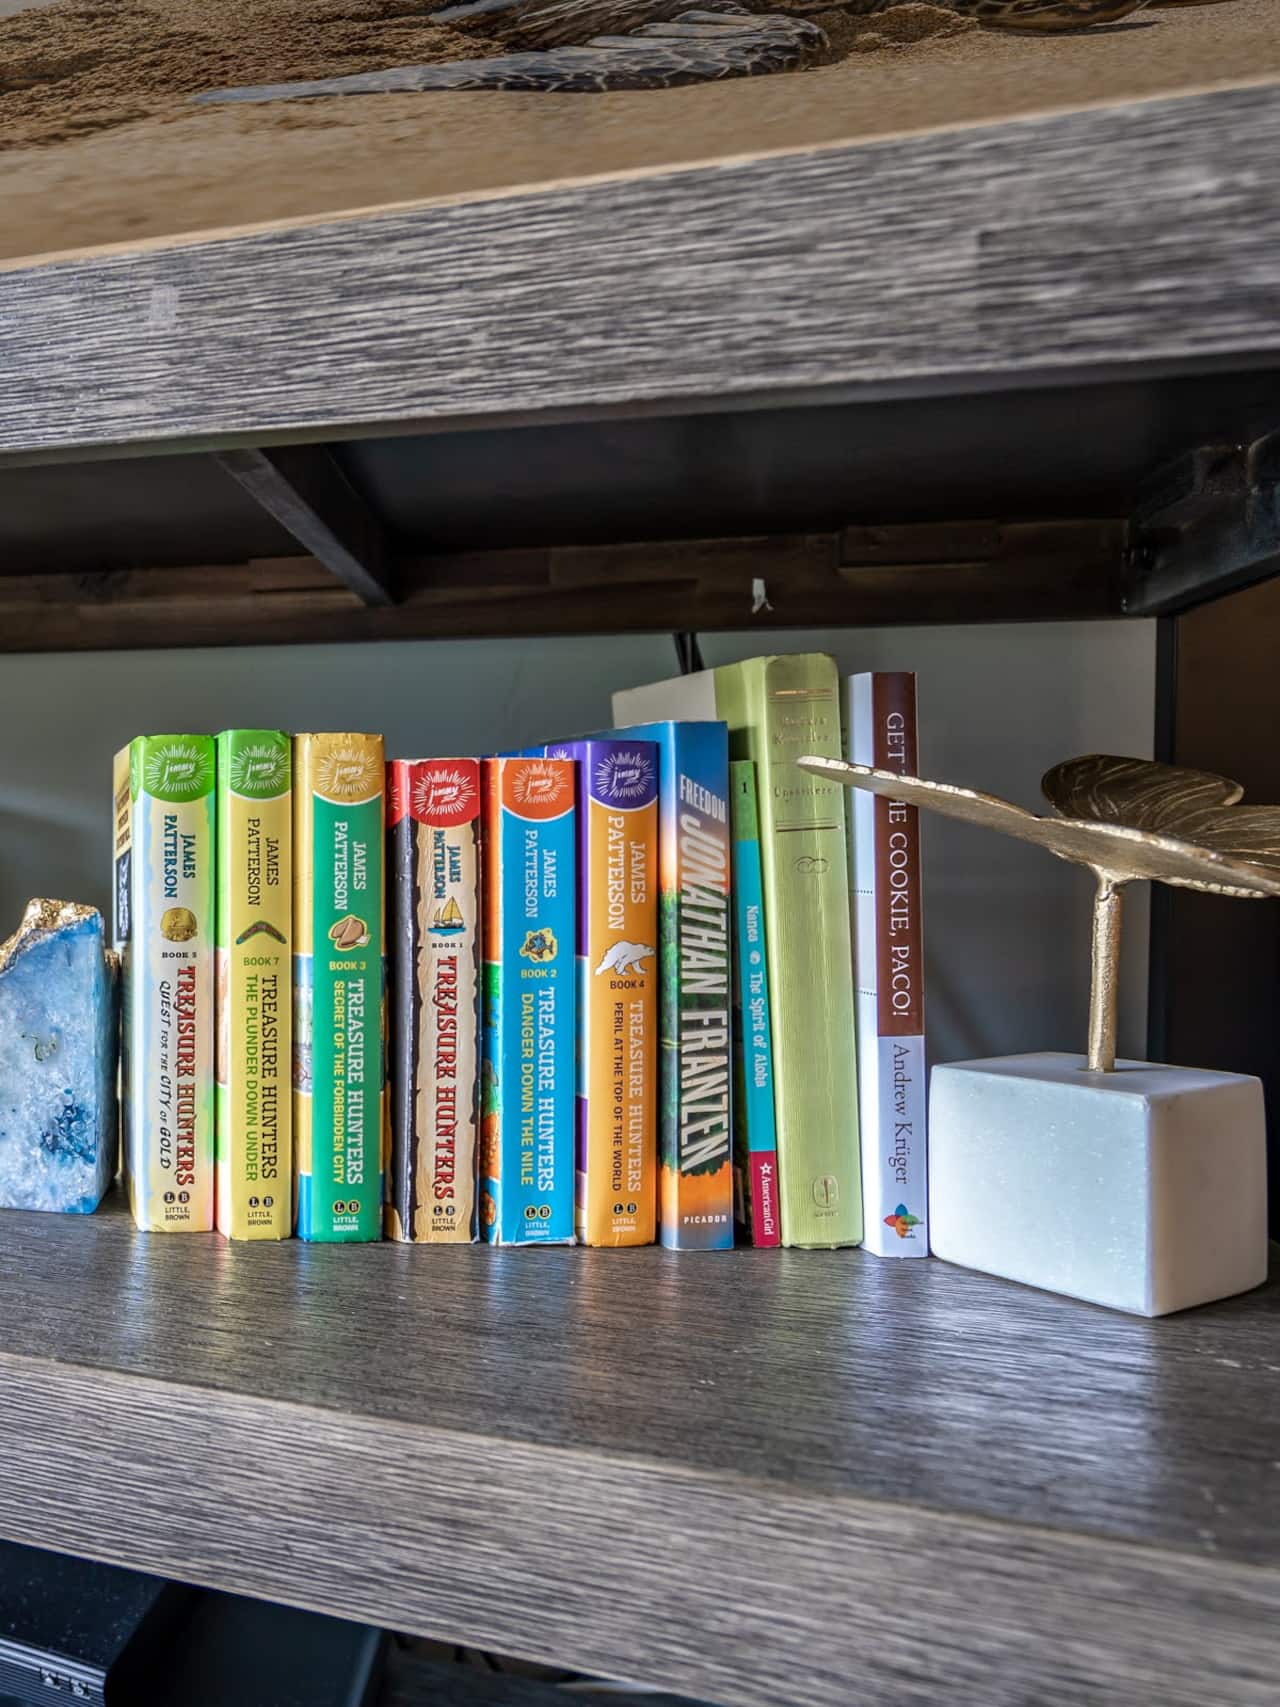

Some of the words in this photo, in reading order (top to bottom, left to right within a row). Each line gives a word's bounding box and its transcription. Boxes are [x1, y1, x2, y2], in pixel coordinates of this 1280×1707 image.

[887, 712, 905, 763] GET
[679, 774, 726, 823] FREEDOM
[742, 783, 747, 793] 1
[164, 815, 177, 898] PATTERSON
[181, 834, 196, 879] JAMES
[248, 818, 260, 906] PATTERSON
[266, 837, 279, 886] JAMES
[334, 821, 348, 910] PATTERSON
[353, 842, 366, 890] JAMES
[434, 830, 446, 899] PATTERSON
[447, 846, 461, 883] JAMES
[525, 830, 538, 919] PATTERSON
[543, 849, 557, 898] JAMES
[608, 816, 625, 930] PATTERSON
[630, 842, 645, 904] JAMES
[680, 815, 728, 994] JONATHAN
[889, 832, 909, 937] COOKIE,
[747, 905, 758, 942] Nanea
[243, 957, 271, 966] BOOK
[273, 957, 279, 965] 7
[329, 960, 357, 971] BOOK
[360, 960, 366, 970] 3
[521, 968, 548, 978] BOOK
[551, 968, 557, 977] 2
[610, 980, 637, 989] BOOK
[639, 980, 645, 988] 4
[750, 972, 762, 994] The
[891, 944, 911, 1016] PACO!
[160, 981, 171, 1026] QUEST
[246, 974, 258, 1003] THE
[333, 981, 345, 1030] SECRET
[176, 966, 196, 1077] TREASURE
[262, 975, 278, 1079] TREASURE
[347, 979, 364, 1083] TREASURE
[434, 955, 458, 1079] TREASURE
[521, 994, 534, 1058] DANGER
[612, 1002, 623, 1034] PERIL
[751, 998, 764, 1031] Spirit
[160, 1031, 168, 1050] FOR
[246, 1007, 258, 1076] PLUNDER
[333, 1033, 345, 1049] OF
[538, 987, 555, 1091] TREASURE
[612, 1038, 623, 1053] AT
[628, 1000, 643, 1098] TREASURE
[753, 1035, 763, 1050] of
[160, 1054, 168, 1073] THE
[333, 1054, 345, 1076] THE
[612, 1055, 623, 1076] THE
[754, 1054, 765, 1087] Aloha
[894, 1044, 912, 1116] Andrew
[160, 1076, 172, 1110] CITY
[246, 1080, 258, 1119] DOWN
[521, 1062, 534, 1113] DOWN
[612, 1080, 623, 1101] TOP
[680, 1010, 728, 1172] FRANZEN
[176, 1083, 196, 1186] HUNTERS
[262, 1085, 278, 1179] HUNTERS
[333, 1080, 345, 1153] FORBIDDEN
[521, 1117, 534, 1148] THE
[612, 1105, 623, 1120] OF
[612, 1124, 623, 1147] THE
[160, 1127, 171, 1169] GOLD
[246, 1123, 258, 1181] UNDER
[347, 1090, 364, 1185] HUNTERS
[434, 1085, 458, 1200] HUNTERS
[538, 1098, 555, 1192] HUNTERS
[628, 1104, 643, 1192] HUNTERS
[889, 1122, 913, 1185] Krüger
[333, 1156, 345, 1184] CITY
[521, 1152, 534, 1185] NILE
[612, 1150, 623, 1191] WORLD
[684, 1215, 727, 1224] PICADOR
[761, 1176, 773, 1217] American
[333, 1224, 359, 1232] BROWN
[525, 1229, 550, 1237] BROWN
[764, 1218, 775, 1235] Girl
